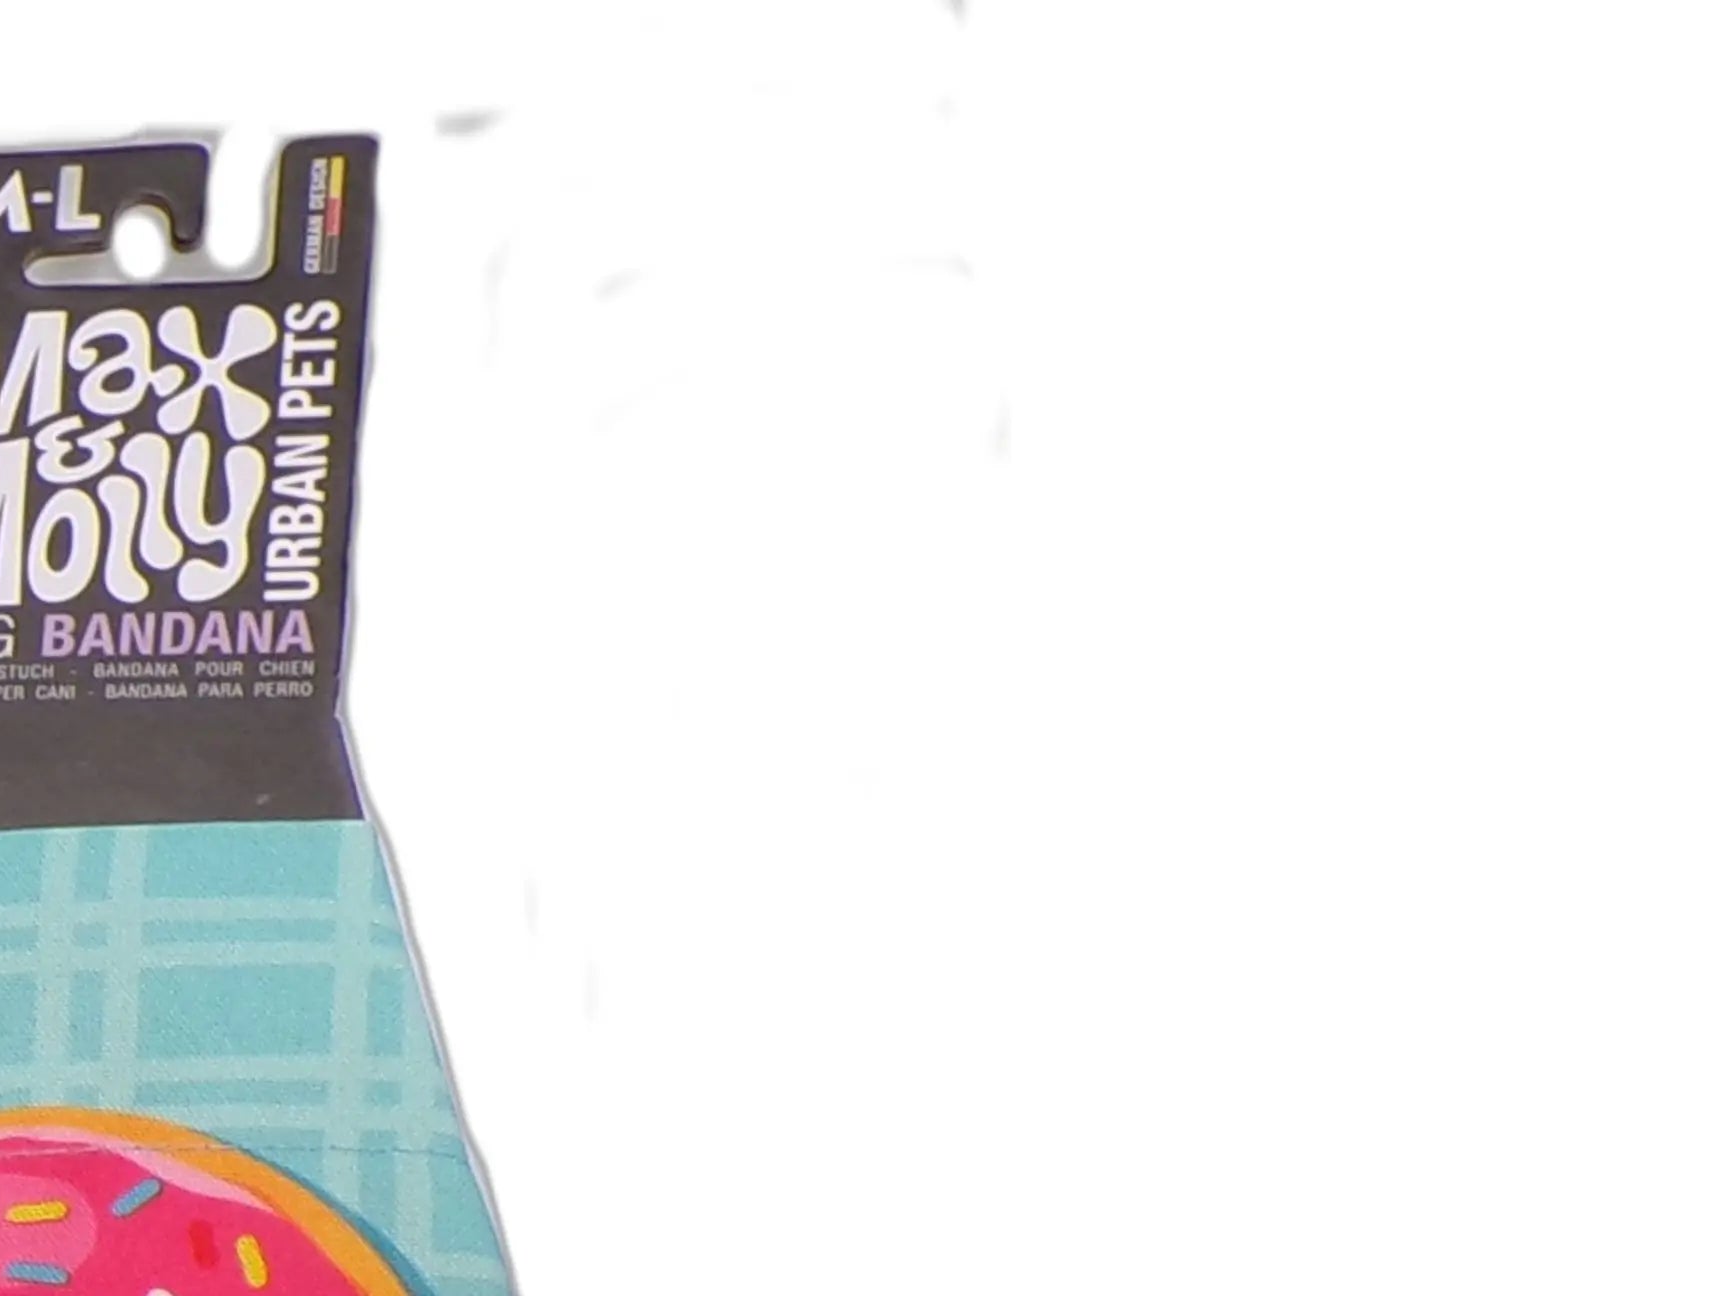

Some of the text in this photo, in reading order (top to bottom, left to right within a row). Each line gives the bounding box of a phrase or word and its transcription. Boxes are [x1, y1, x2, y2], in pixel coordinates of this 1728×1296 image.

[32, 415, 124, 484] &
[262, 299, 341, 602] URBAN PETS
[42, 610, 315, 656] BANDANA
[35, 684, 77, 699] CANI
[105, 683, 188, 699] BANDANA
[197, 682, 245, 698] PARA
[253, 681, 314, 698] PERRO
[93, 662, 180, 678] BANDANA
[195, 661, 244, 676] POUR
[259, 660, 315, 676] CHIEN
